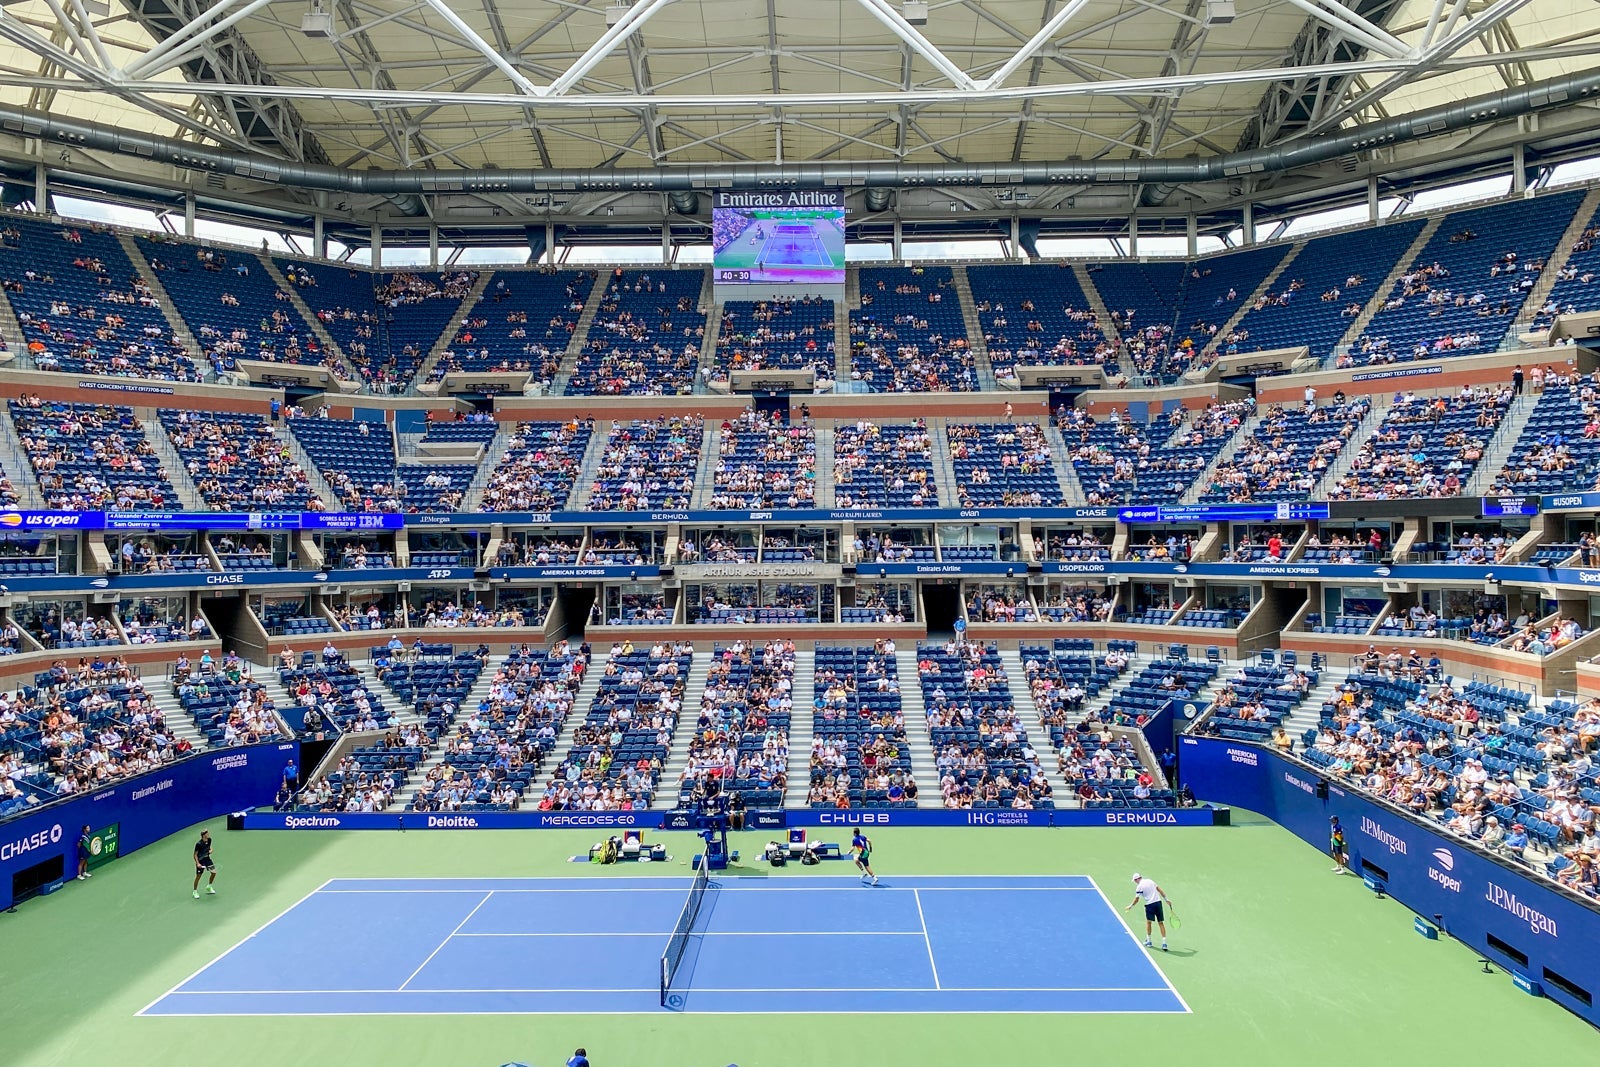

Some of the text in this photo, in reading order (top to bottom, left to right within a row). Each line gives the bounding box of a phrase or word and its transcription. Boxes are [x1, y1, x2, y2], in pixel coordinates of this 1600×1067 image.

[720, 191, 836, 206] Emirates Airline
[723, 272, 732, 280] 40
[739, 272, 749, 280] 30
[1553, 496, 1582, 506] #USOPEN
[1502, 506, 1522, 514] IBM
[26, 514, 79, 526] us open
[359, 516, 384, 527] IBM
[420, 516, 450, 524] J.P.Morgan
[532, 514, 552, 522] IBM
[427, 570, 451, 578] ATP
[704, 568, 814, 576] ARTHUR ASHE STADIUM
[207, 574, 244, 584] CHASE
[1227, 748, 1257, 759] AMERICAN
[212, 754, 247, 765] AMERICAN
[1232, 756, 1257, 766] EXPRESS
[217, 760, 247, 770] EXPRESS
[133, 780, 173, 800] Emirates Airline
[285, 816, 337, 829] Spectrum
[428, 817, 478, 827] Deloitte.
[542, 816, 635, 825] MERCEDES-EQ
[820, 814, 889, 822] CHUBB
[968, 813, 994, 824] IHG
[1107, 814, 1176, 822] BERMUDA
[1361, 816, 1407, 855] J.P.Morgan
[1, 830, 48, 860] CHASE
[1429, 867, 1460, 893] us open
[1486, 882, 1558, 937] J.P.Morgan
